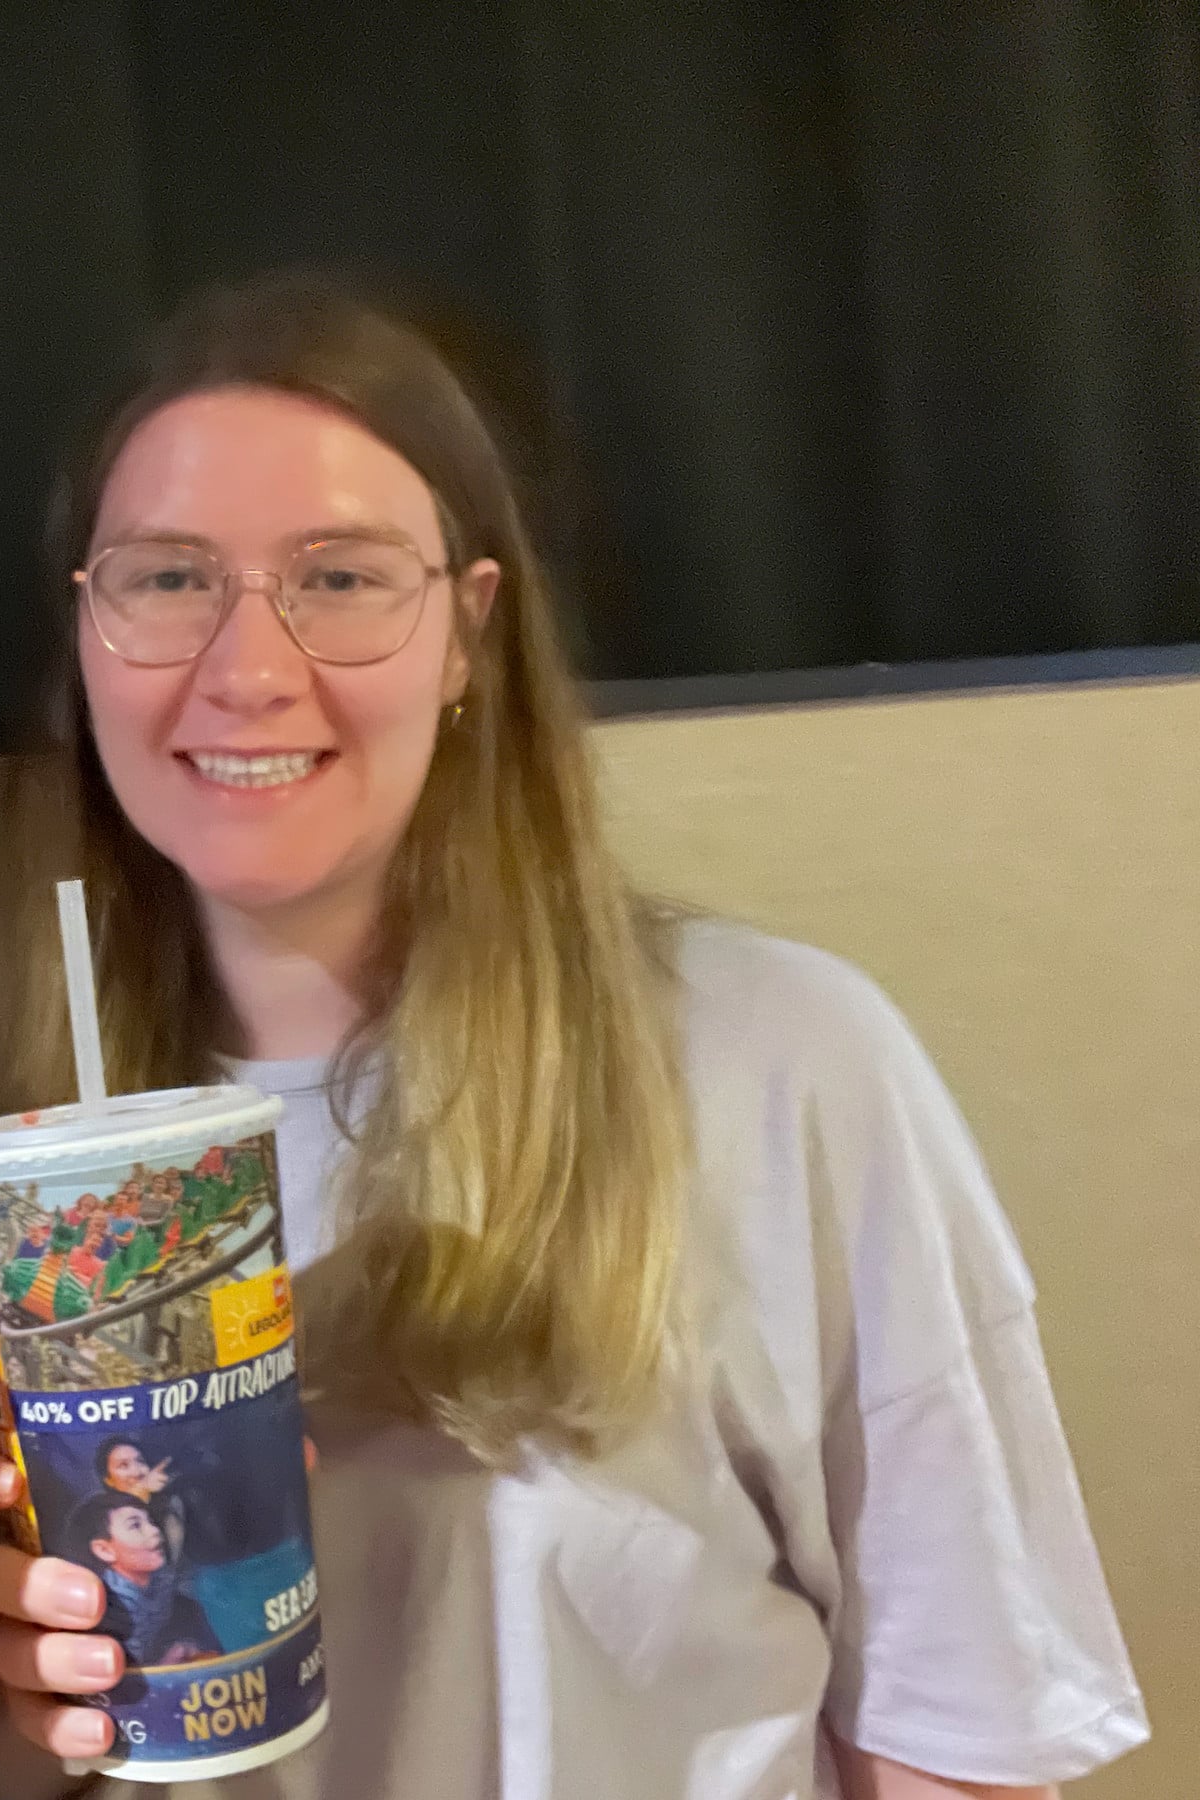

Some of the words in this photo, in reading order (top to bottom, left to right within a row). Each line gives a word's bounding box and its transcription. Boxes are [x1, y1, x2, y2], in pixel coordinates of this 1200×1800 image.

[21, 1401, 73, 1424] 40%
[78, 1397, 135, 1423] OFF
[148, 1378, 199, 1420] TOP
[181, 1665, 267, 1712] JOIN
[183, 1697, 267, 1742] NOW
